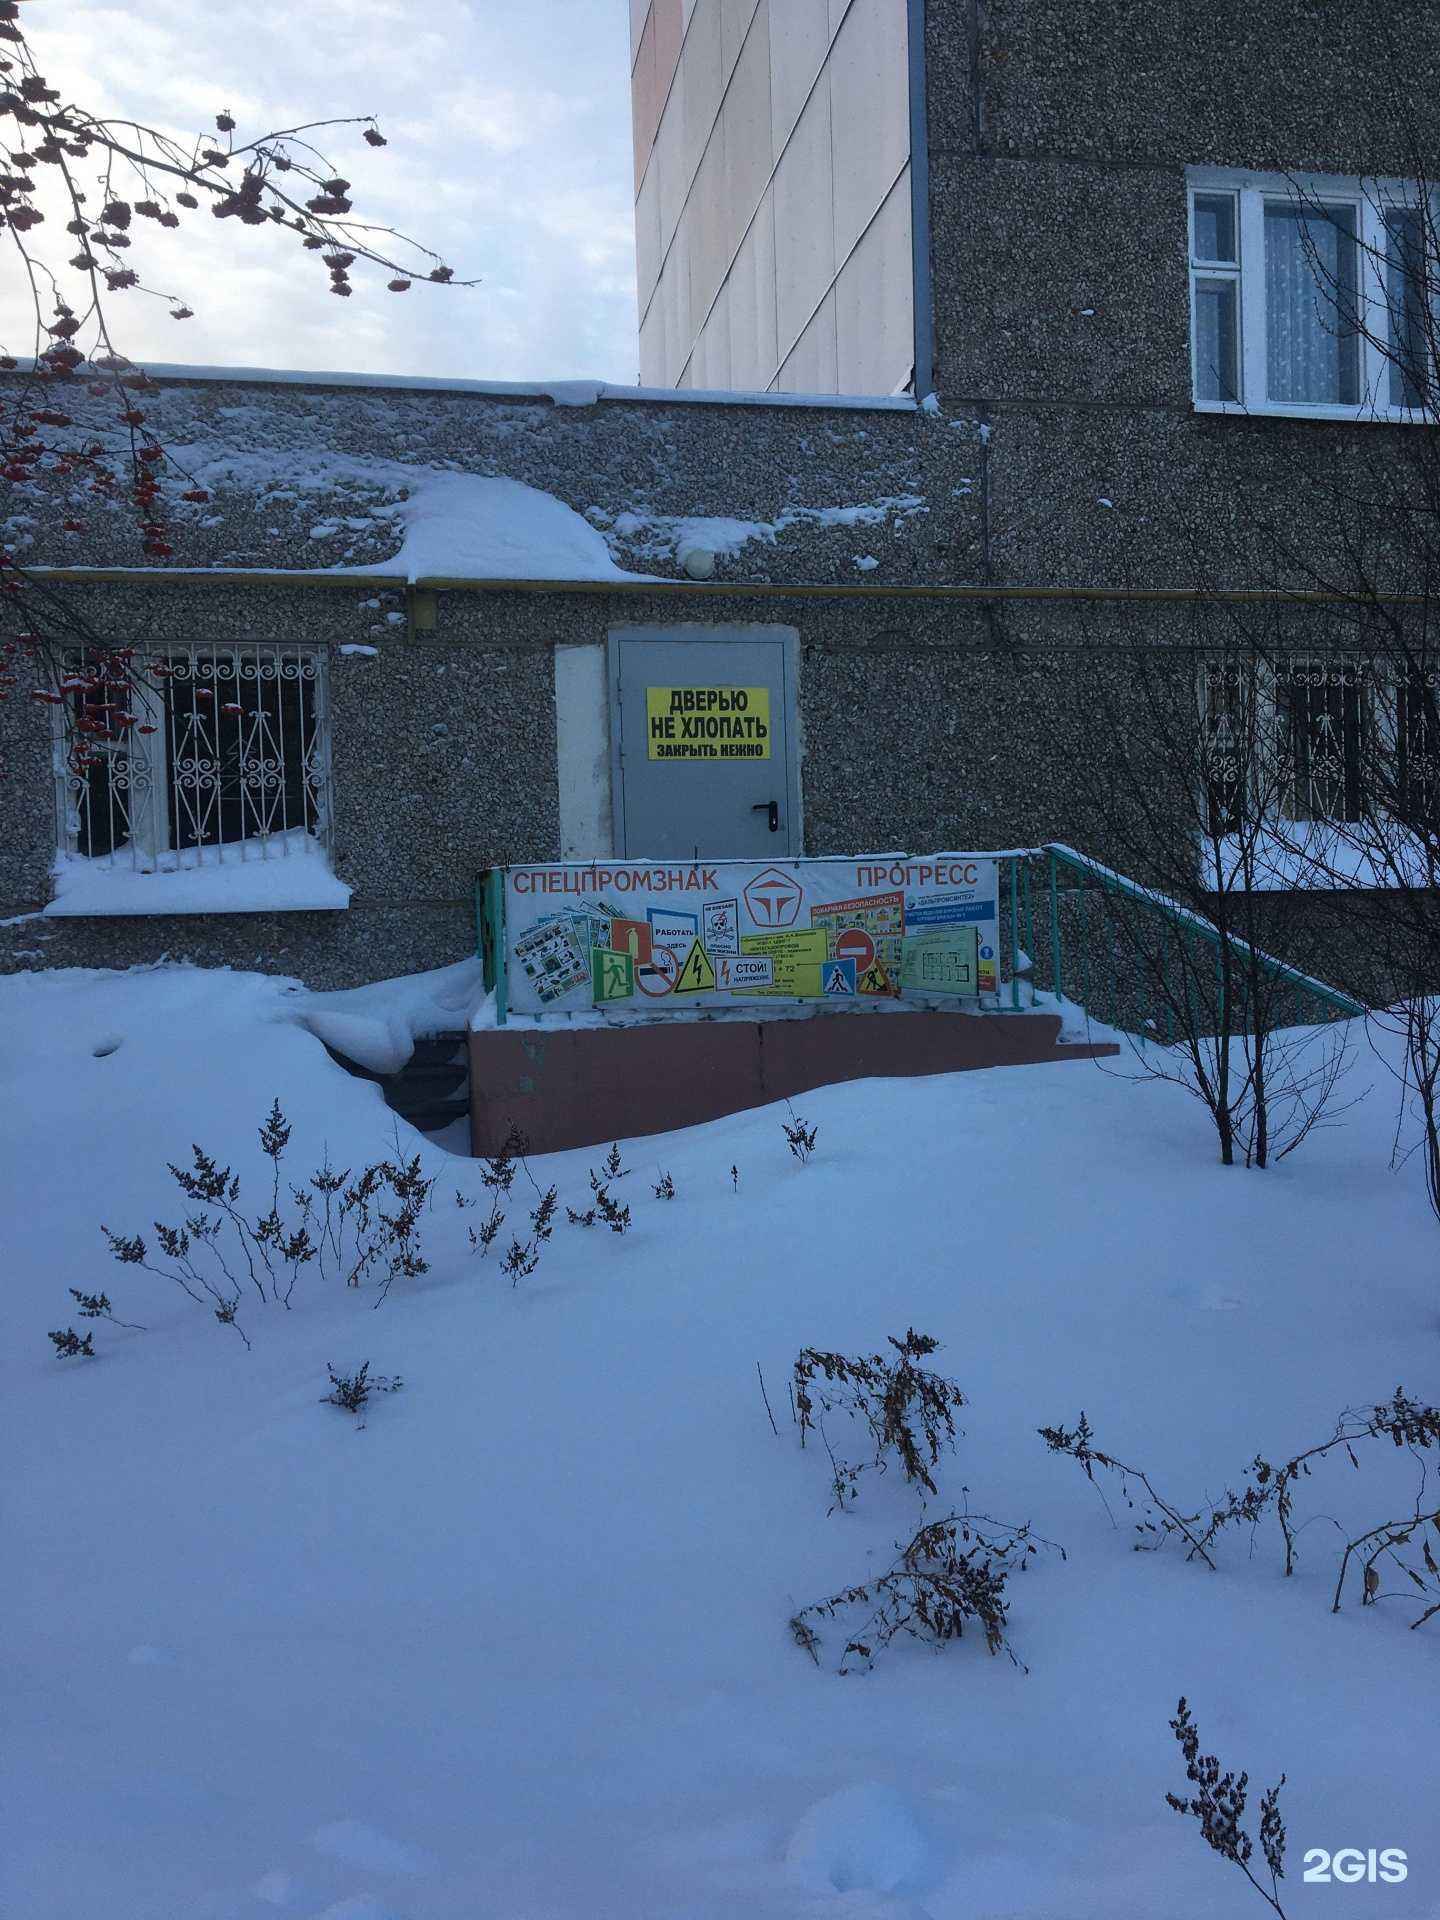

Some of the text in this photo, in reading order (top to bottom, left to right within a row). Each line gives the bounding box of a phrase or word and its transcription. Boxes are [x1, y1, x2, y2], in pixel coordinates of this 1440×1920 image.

[670, 690, 748, 715] ДВЕРЬЮ
[651, 716, 768, 739] НЕ ХЛОПАТЬ
[657, 744, 763, 757] ЗАКРЫТЬ НЕЖНО
[513, 869, 719, 896] СПЕЦПРОМЗНАК
[857, 863, 978, 887] ПРОГРЕСС
[655, 928, 694, 936] РАБОТАТЬ
[735, 960, 767, 974] СТОЙ!
